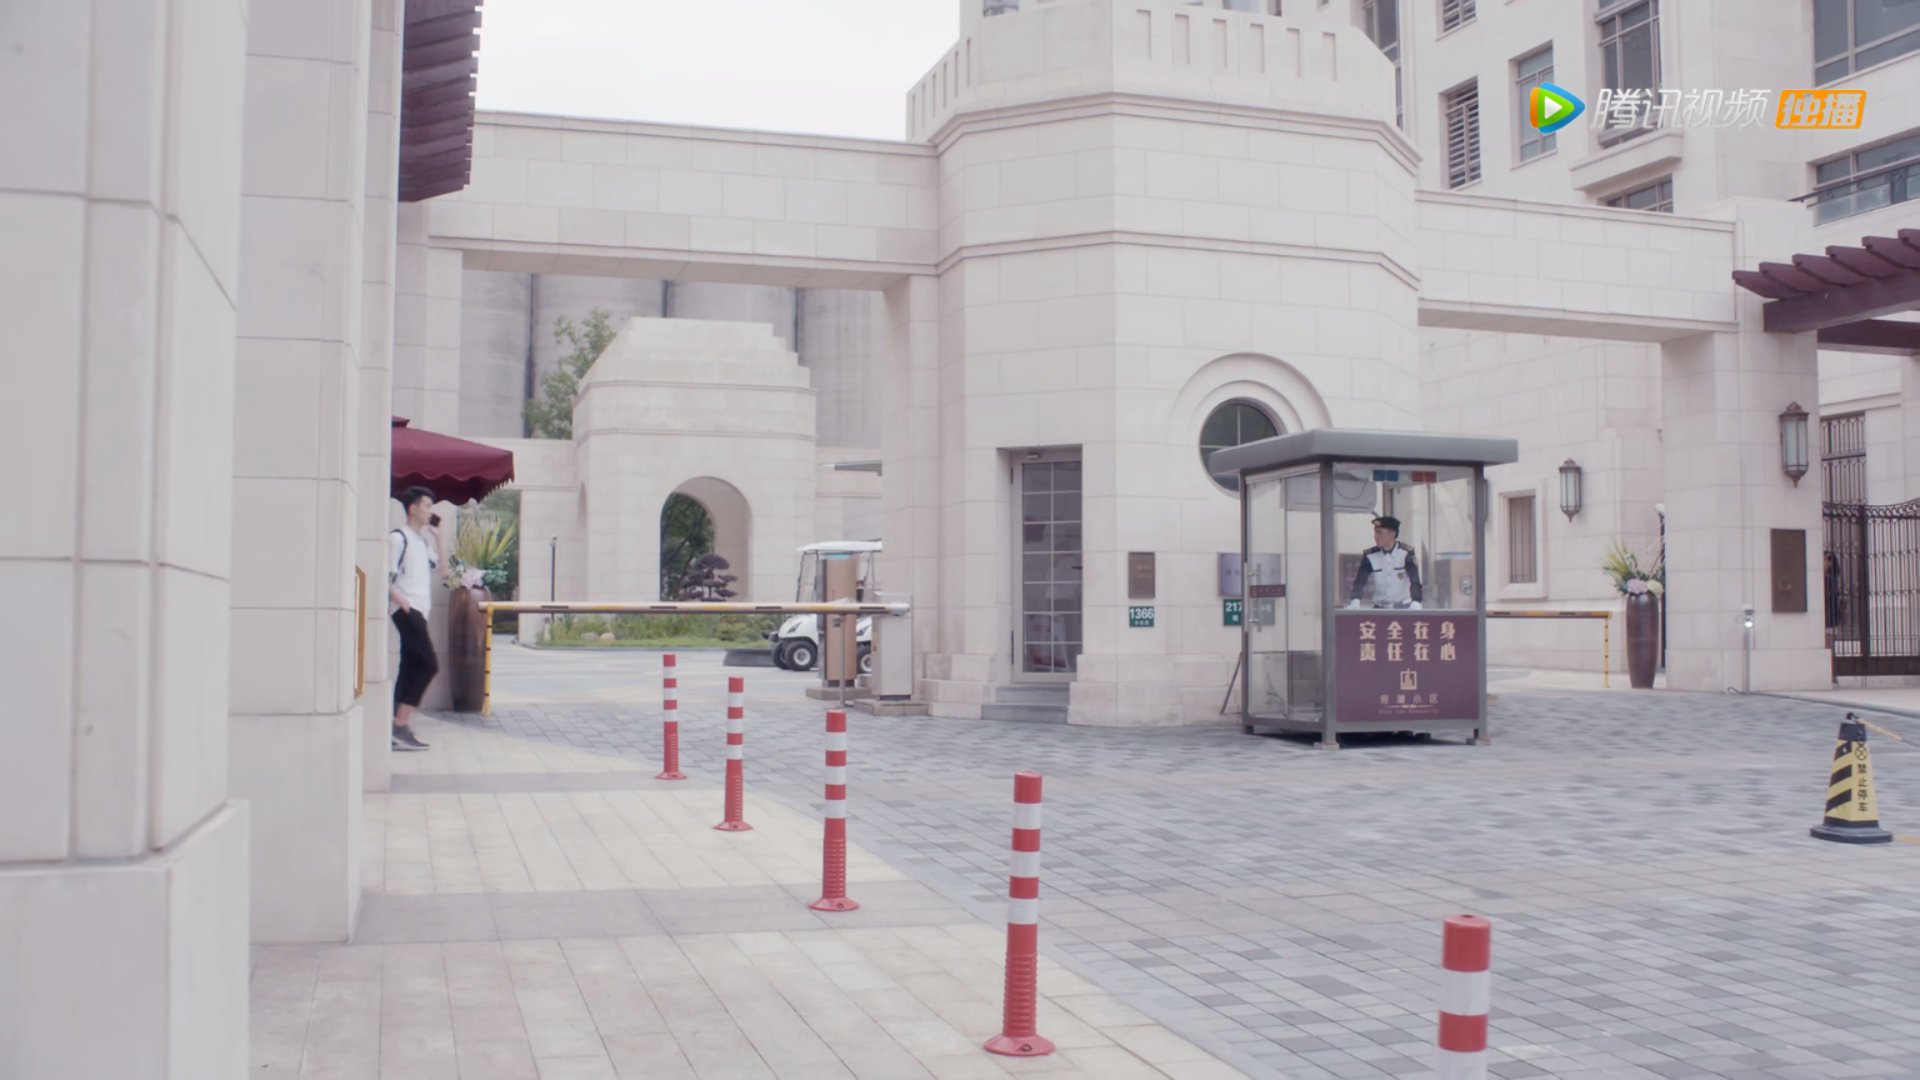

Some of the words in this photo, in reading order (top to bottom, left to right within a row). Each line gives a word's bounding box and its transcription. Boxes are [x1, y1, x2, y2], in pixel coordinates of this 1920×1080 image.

[1359, 621, 1456, 640] 安全在身
[1359, 642, 1456, 661] 责任在心
